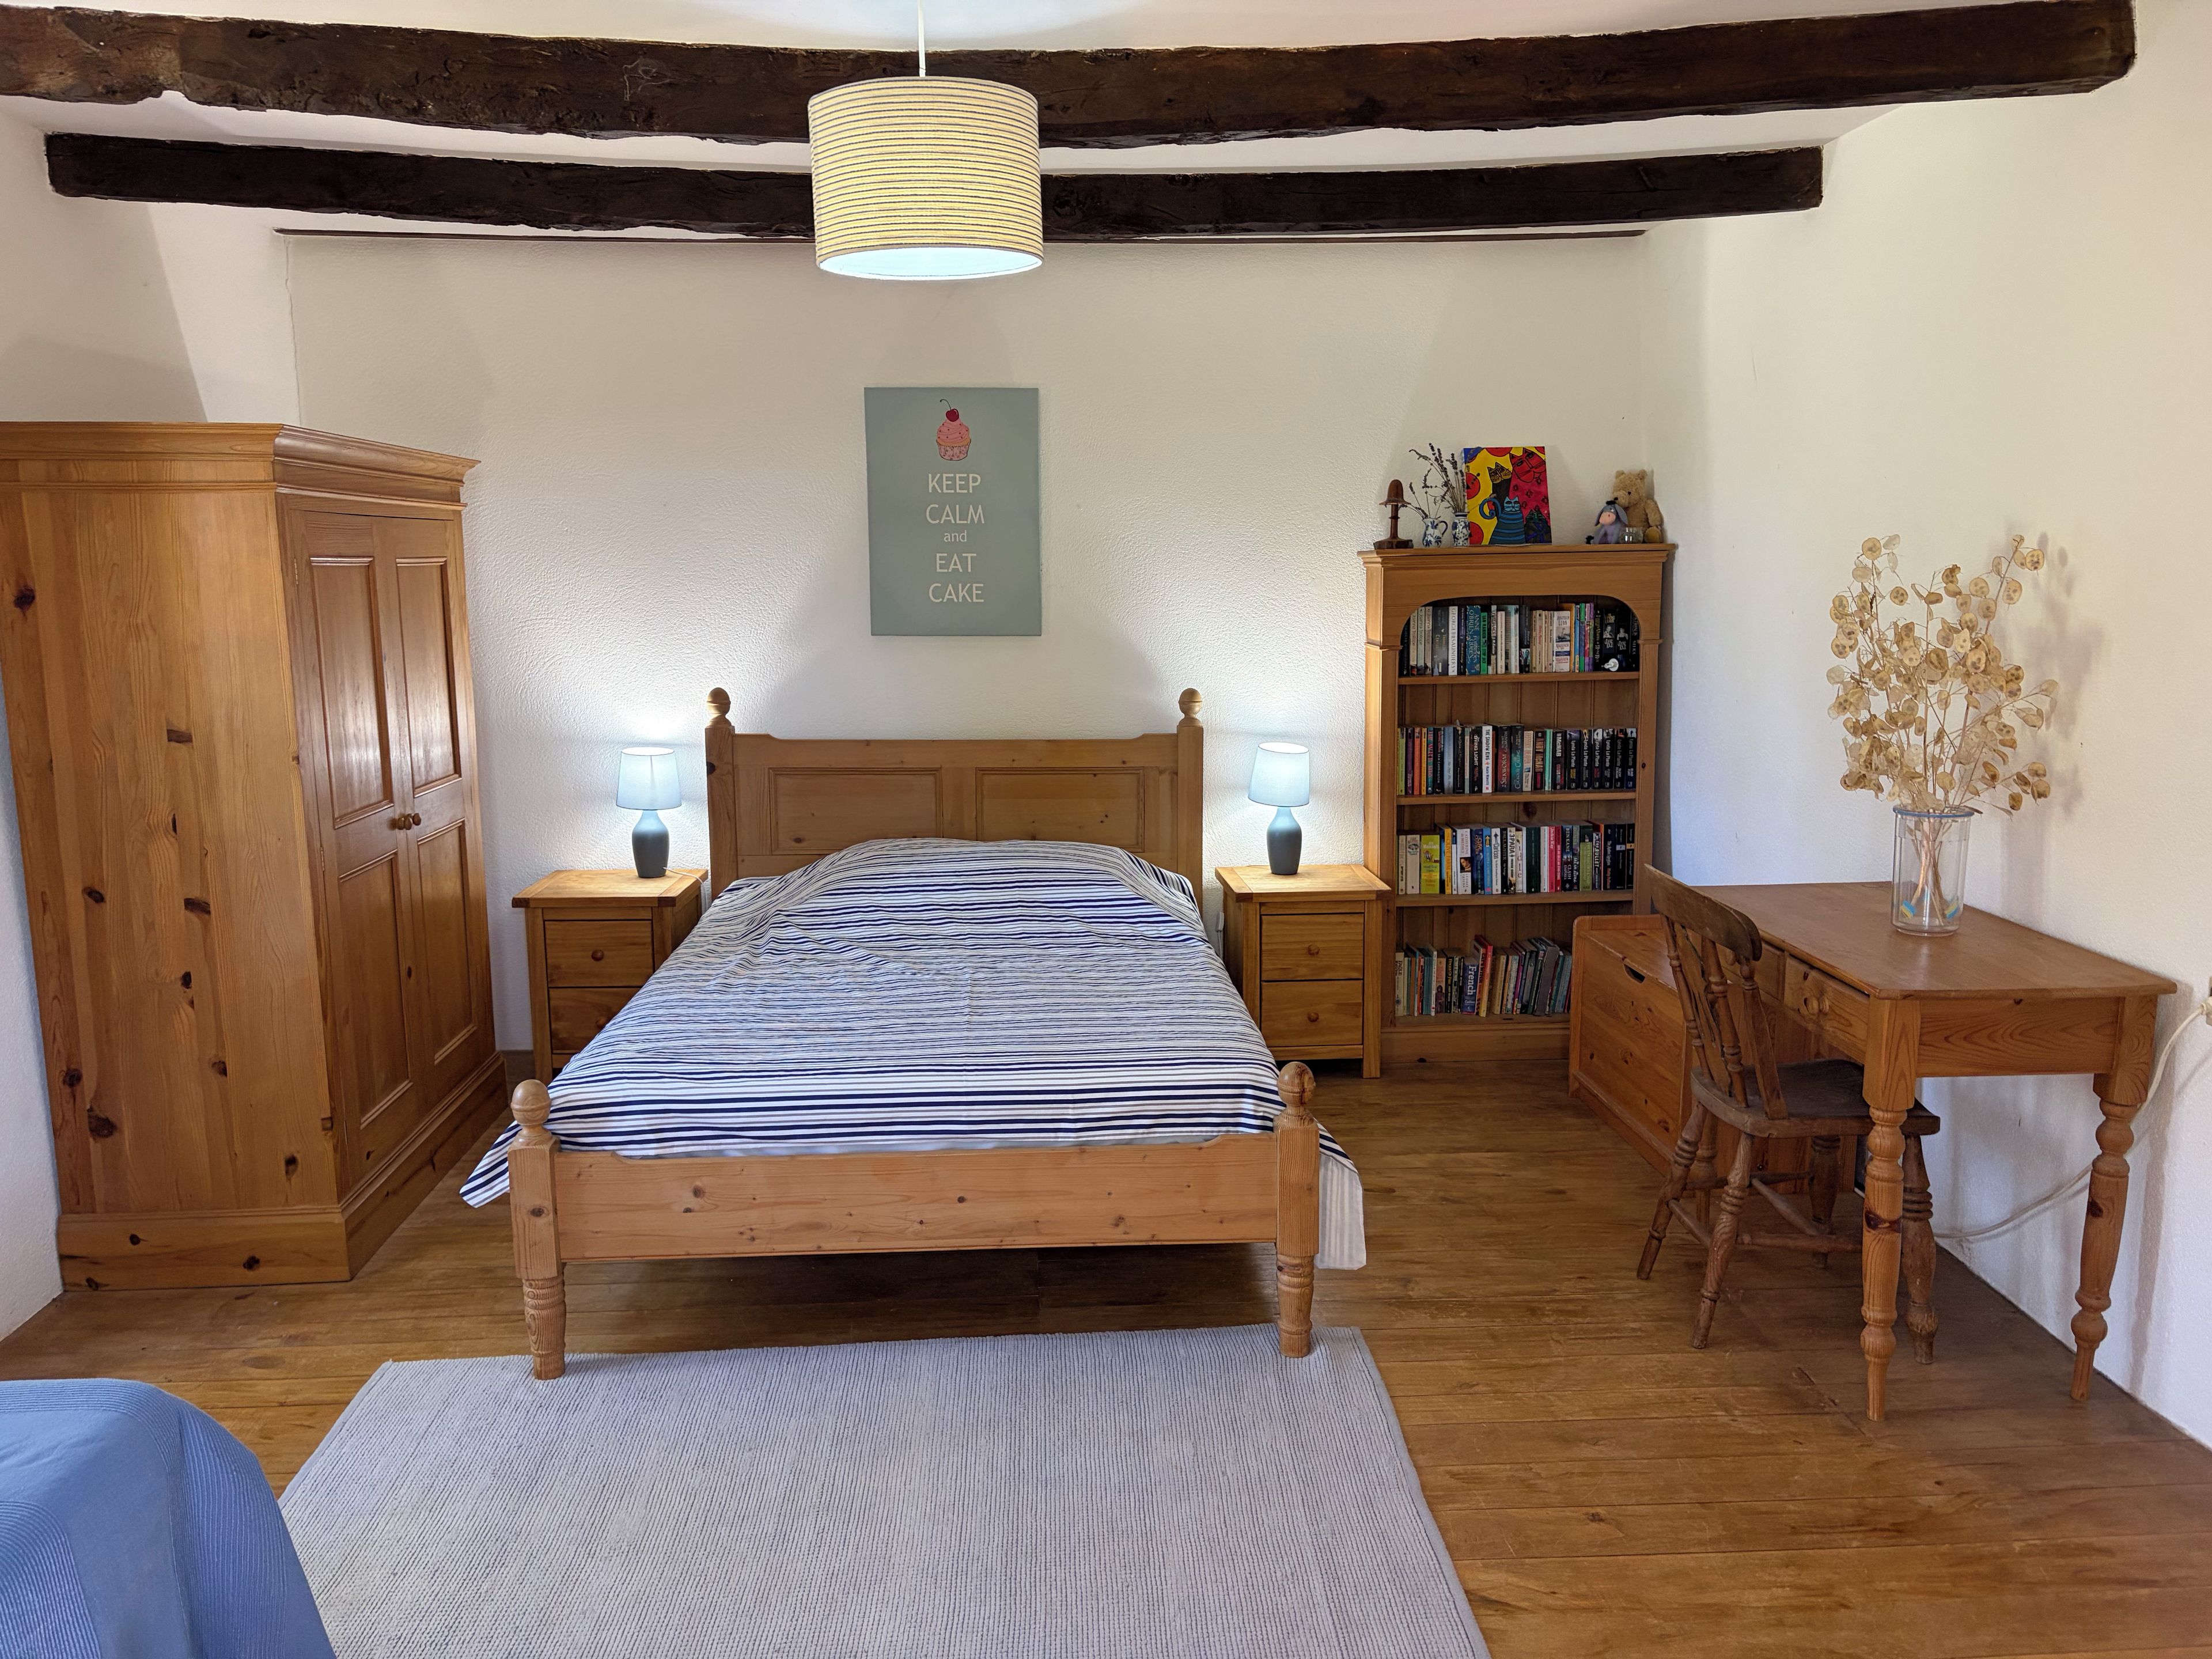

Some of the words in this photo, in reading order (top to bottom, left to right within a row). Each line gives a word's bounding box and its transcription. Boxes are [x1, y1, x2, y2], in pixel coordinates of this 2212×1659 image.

[928, 474, 981, 493] KEEP
[925, 504, 985, 524] CALM
[944, 530, 968, 542] and
[936, 553, 977, 573] EAT
[929, 583, 984, 603] CAKE
[1535, 737, 1544, 752] ANDY
[1500, 754, 1508, 785] SILKWORM
[1467, 965, 1477, 995] French
